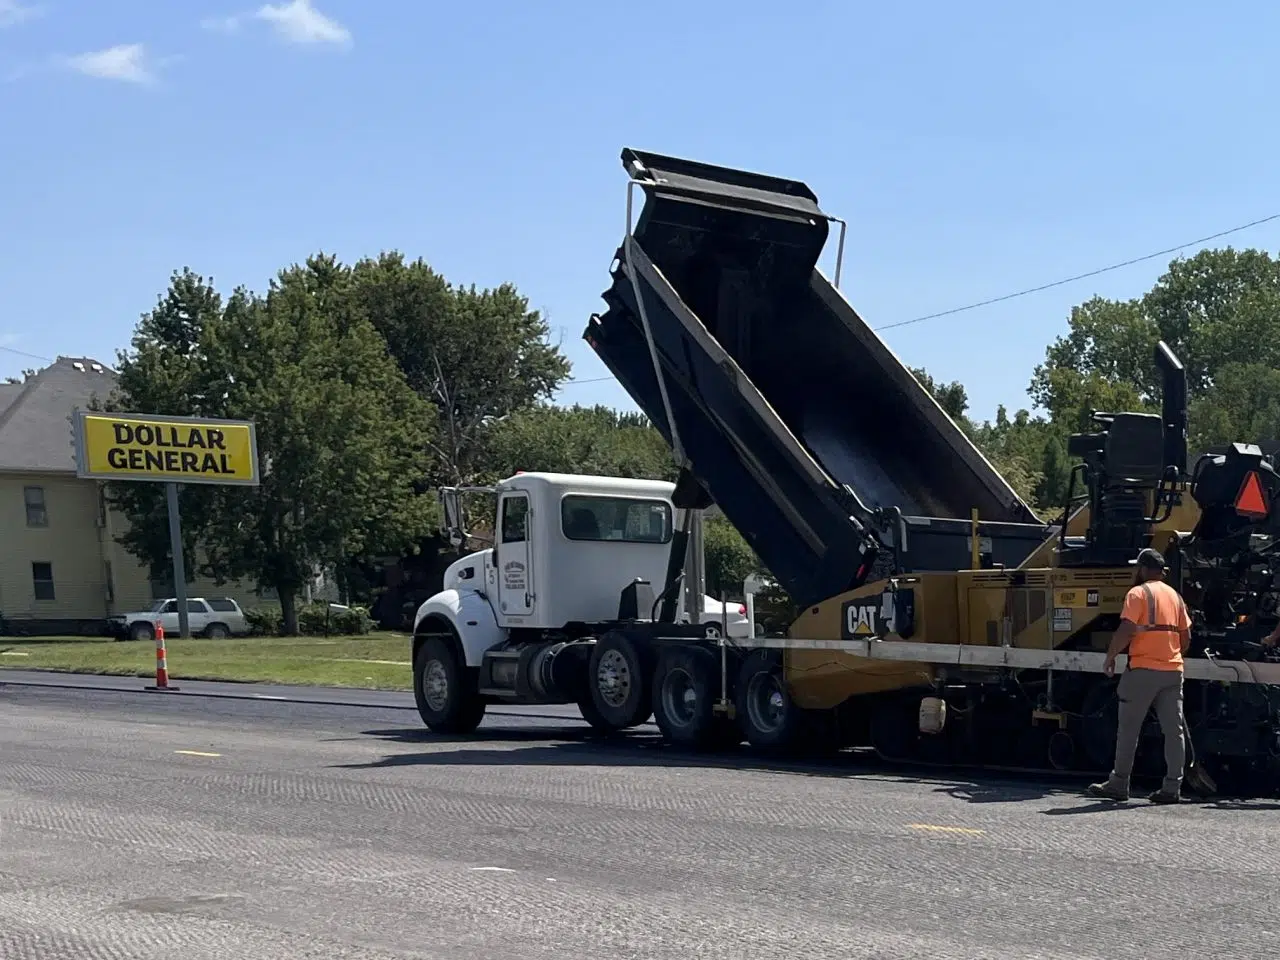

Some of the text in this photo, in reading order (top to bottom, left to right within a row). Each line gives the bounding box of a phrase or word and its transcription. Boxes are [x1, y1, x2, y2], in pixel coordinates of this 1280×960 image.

[113, 423, 226, 450] DOLLAR
[107, 448, 236, 474] GENERAL
[847, 605, 877, 634] CAT
